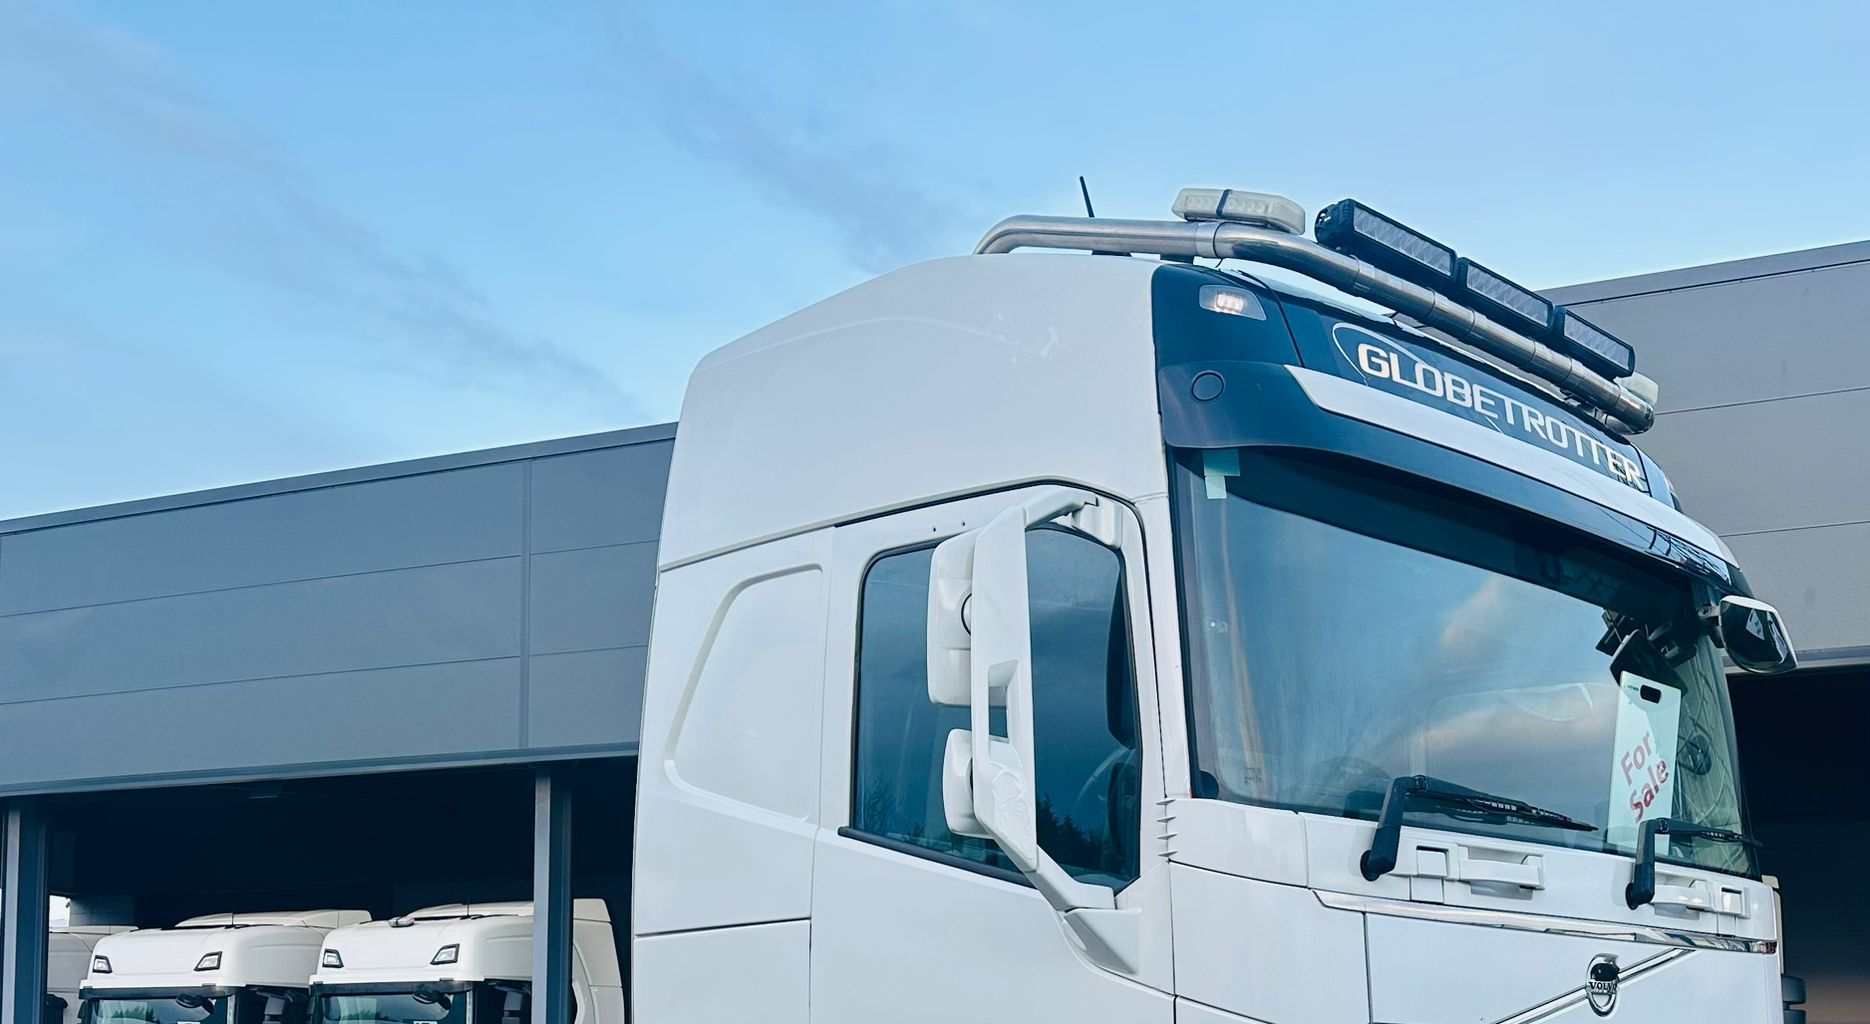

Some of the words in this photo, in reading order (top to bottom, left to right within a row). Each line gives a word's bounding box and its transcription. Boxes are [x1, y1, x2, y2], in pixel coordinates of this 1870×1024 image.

[1357, 342, 1645, 490] GLOBETROTTER
[1620, 730, 1655, 786] For
[1629, 760, 1669, 824] Sale
